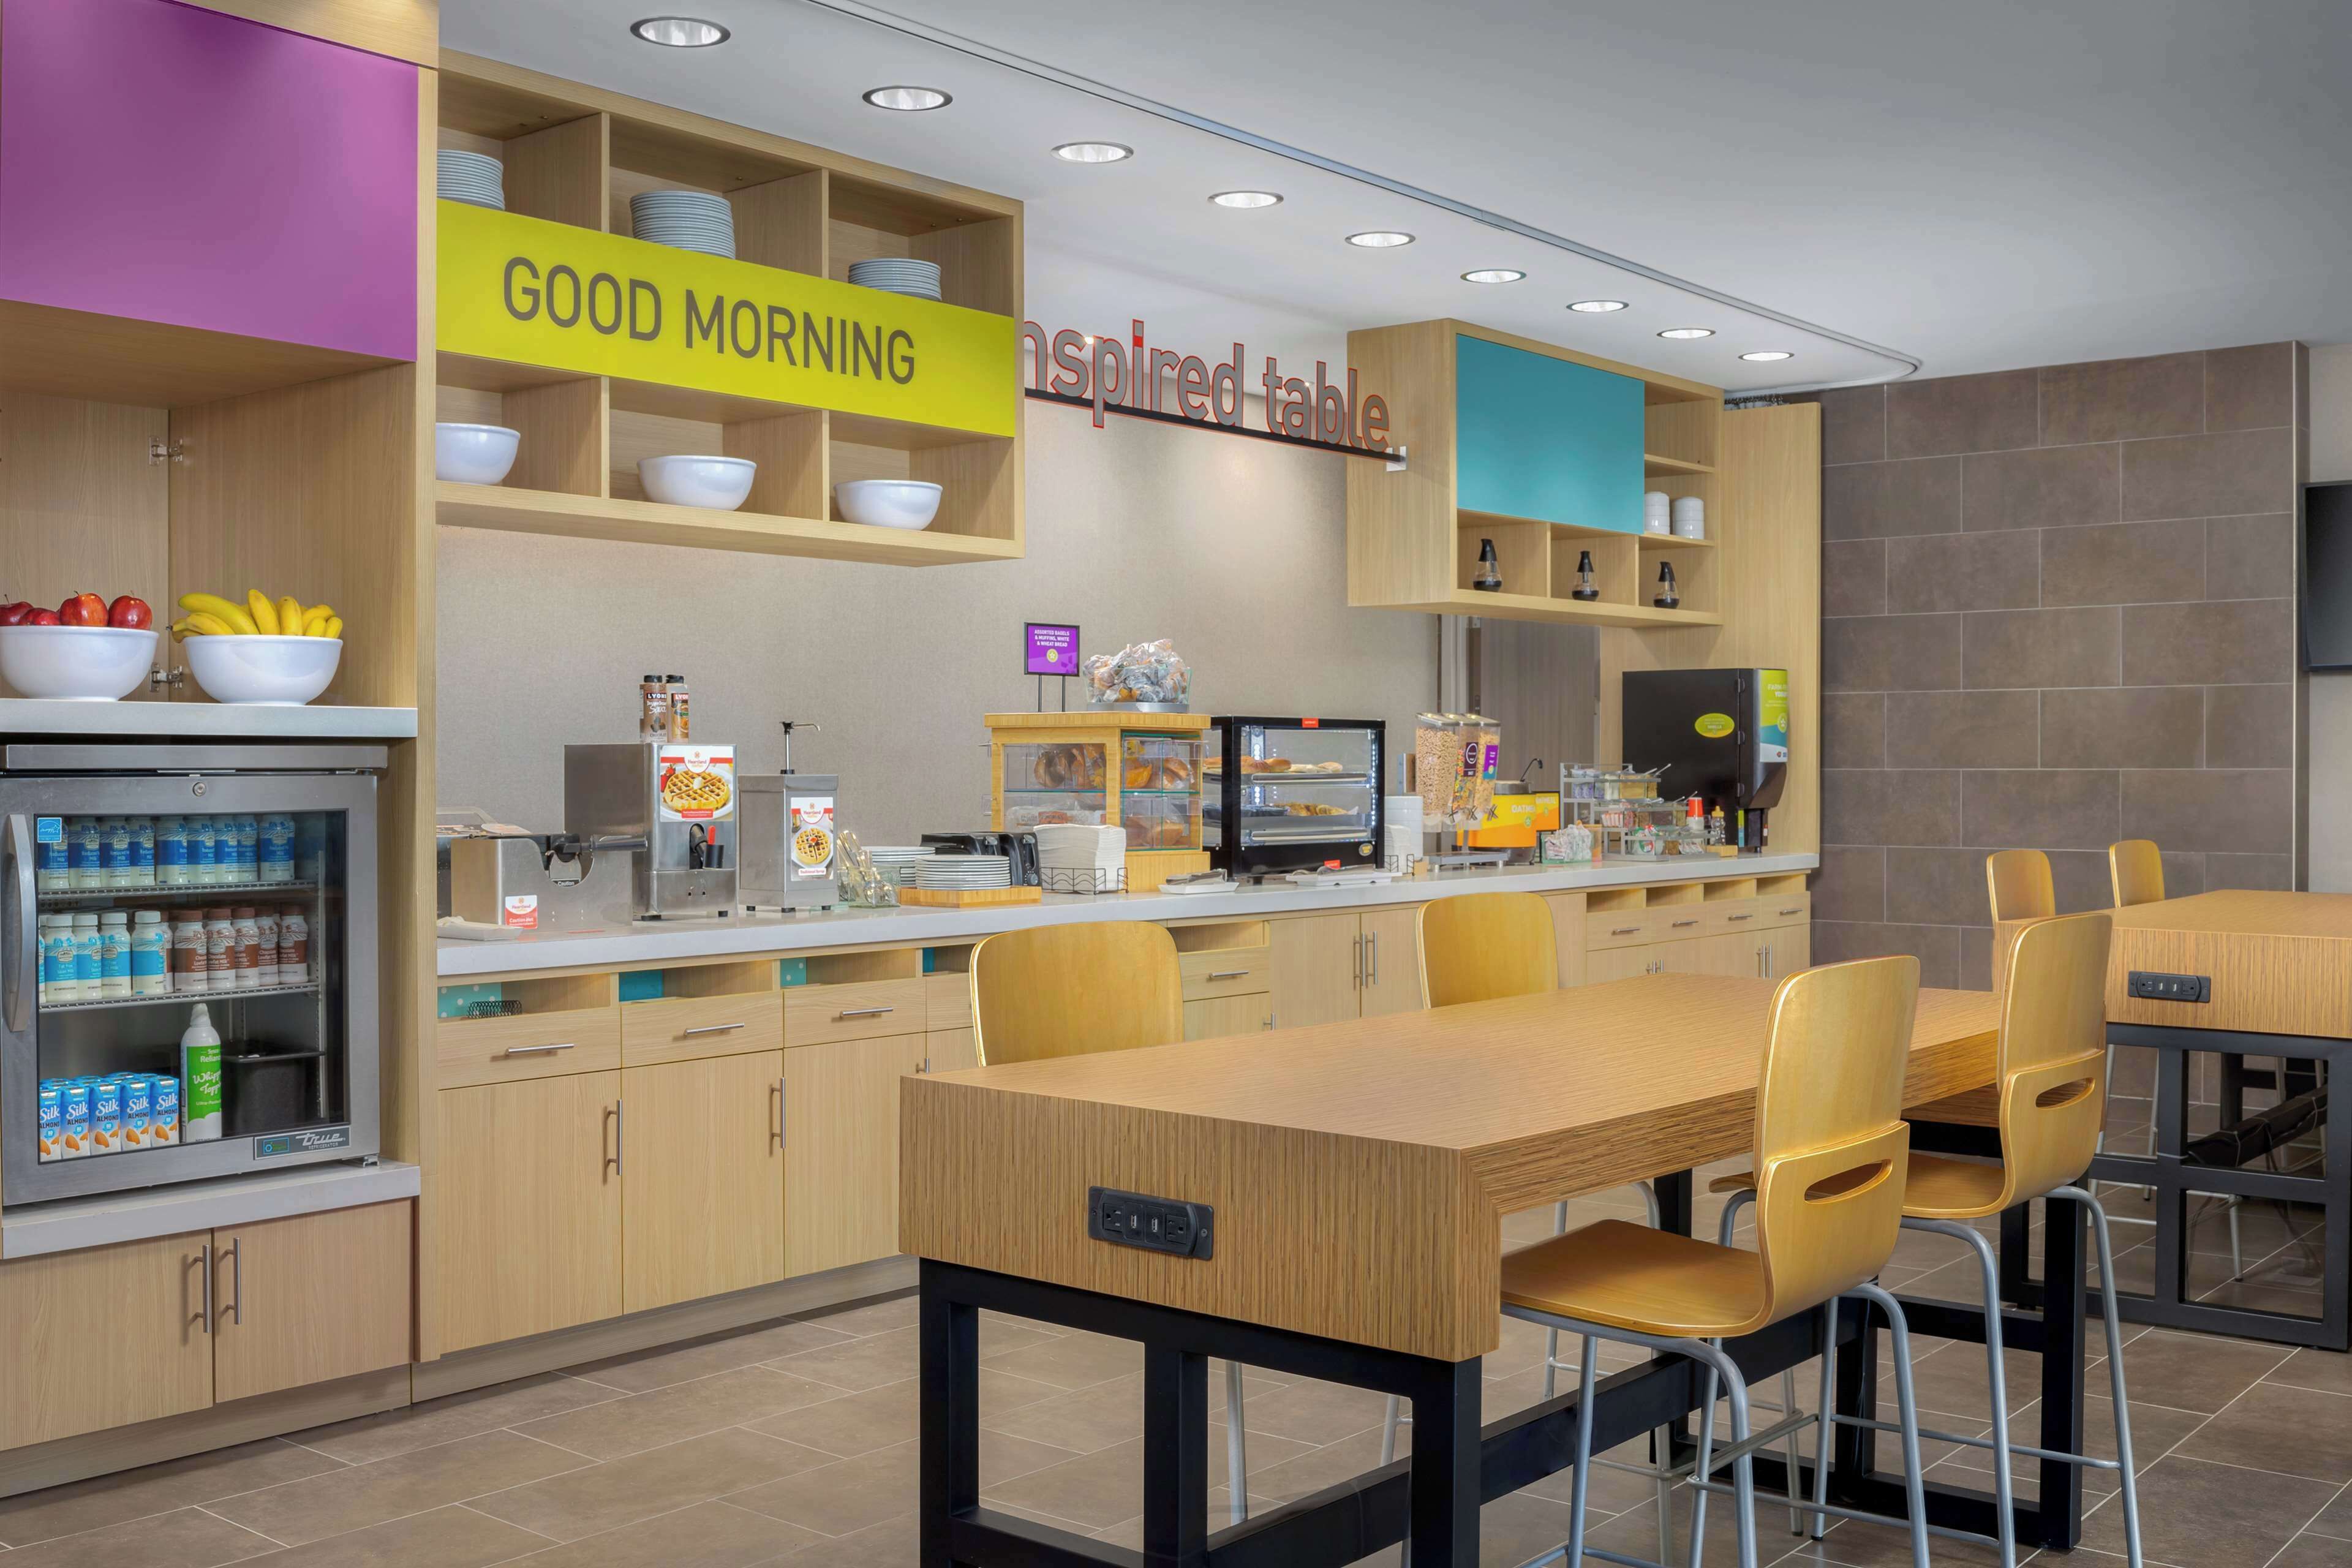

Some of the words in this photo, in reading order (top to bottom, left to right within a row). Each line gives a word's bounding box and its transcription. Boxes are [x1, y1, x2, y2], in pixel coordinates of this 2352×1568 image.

[503, 256, 662, 341] GOOD
[685, 288, 915, 385] MORNING
[1262, 356, 1390, 453] table
[66, 1101, 89, 1120] Silk
[96, 1098, 119, 1116] Silk
[127, 1096, 149, 1113] Silk
[156, 1093, 178, 1110] Silk
[40, 1105, 60, 1123] Silk
